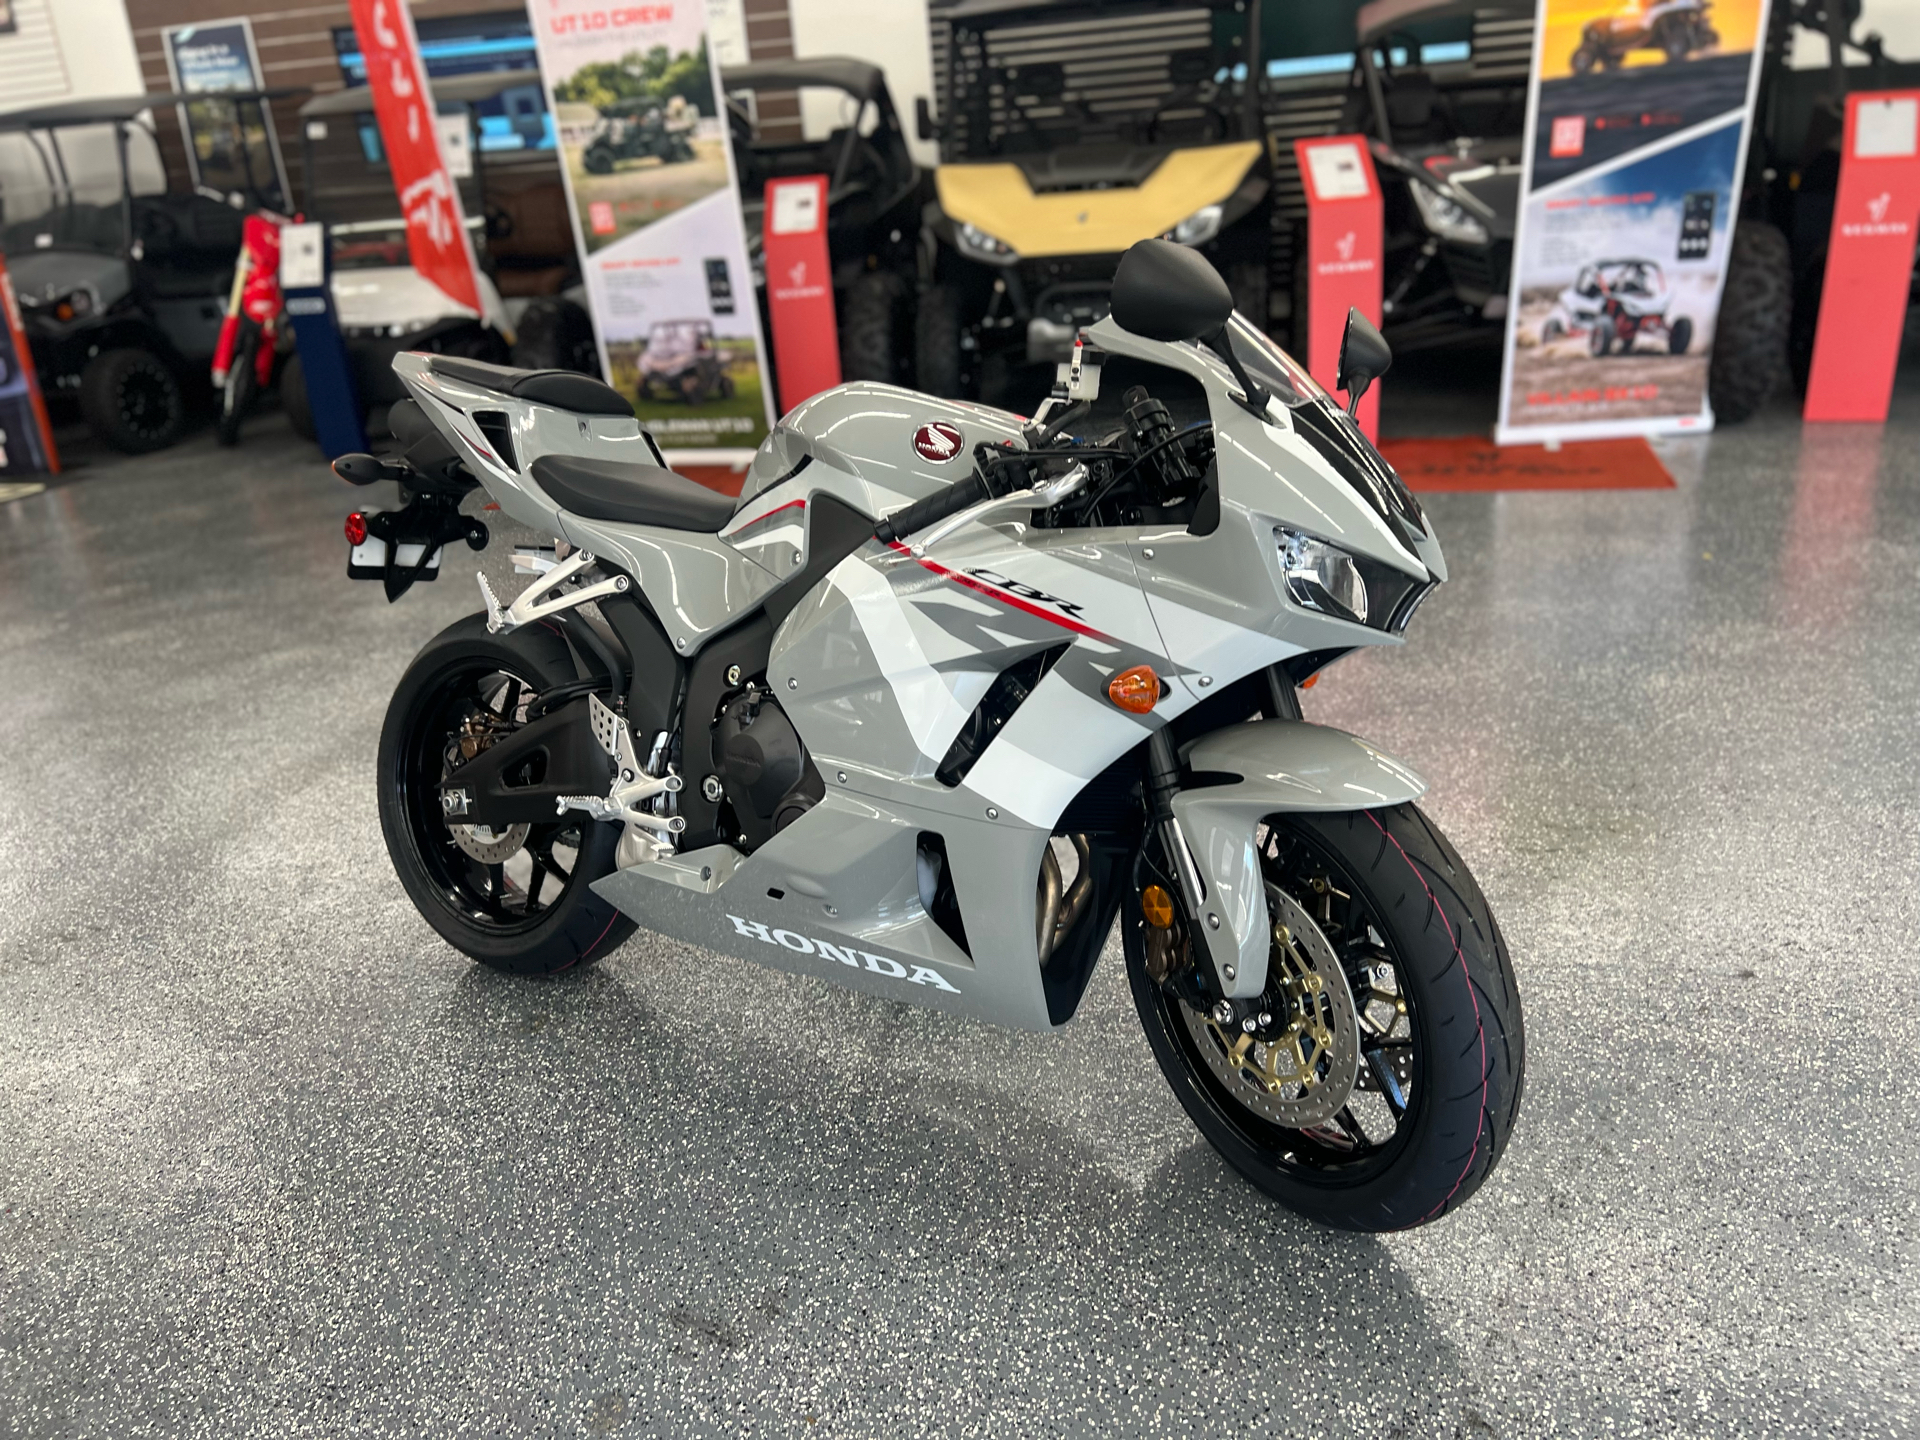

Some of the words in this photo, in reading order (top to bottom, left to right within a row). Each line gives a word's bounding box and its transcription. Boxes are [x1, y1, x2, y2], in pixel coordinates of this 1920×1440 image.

[918, 441, 951, 458] HONDA
[962, 567, 1087, 622] CBR
[725, 913, 962, 995] HONDA
